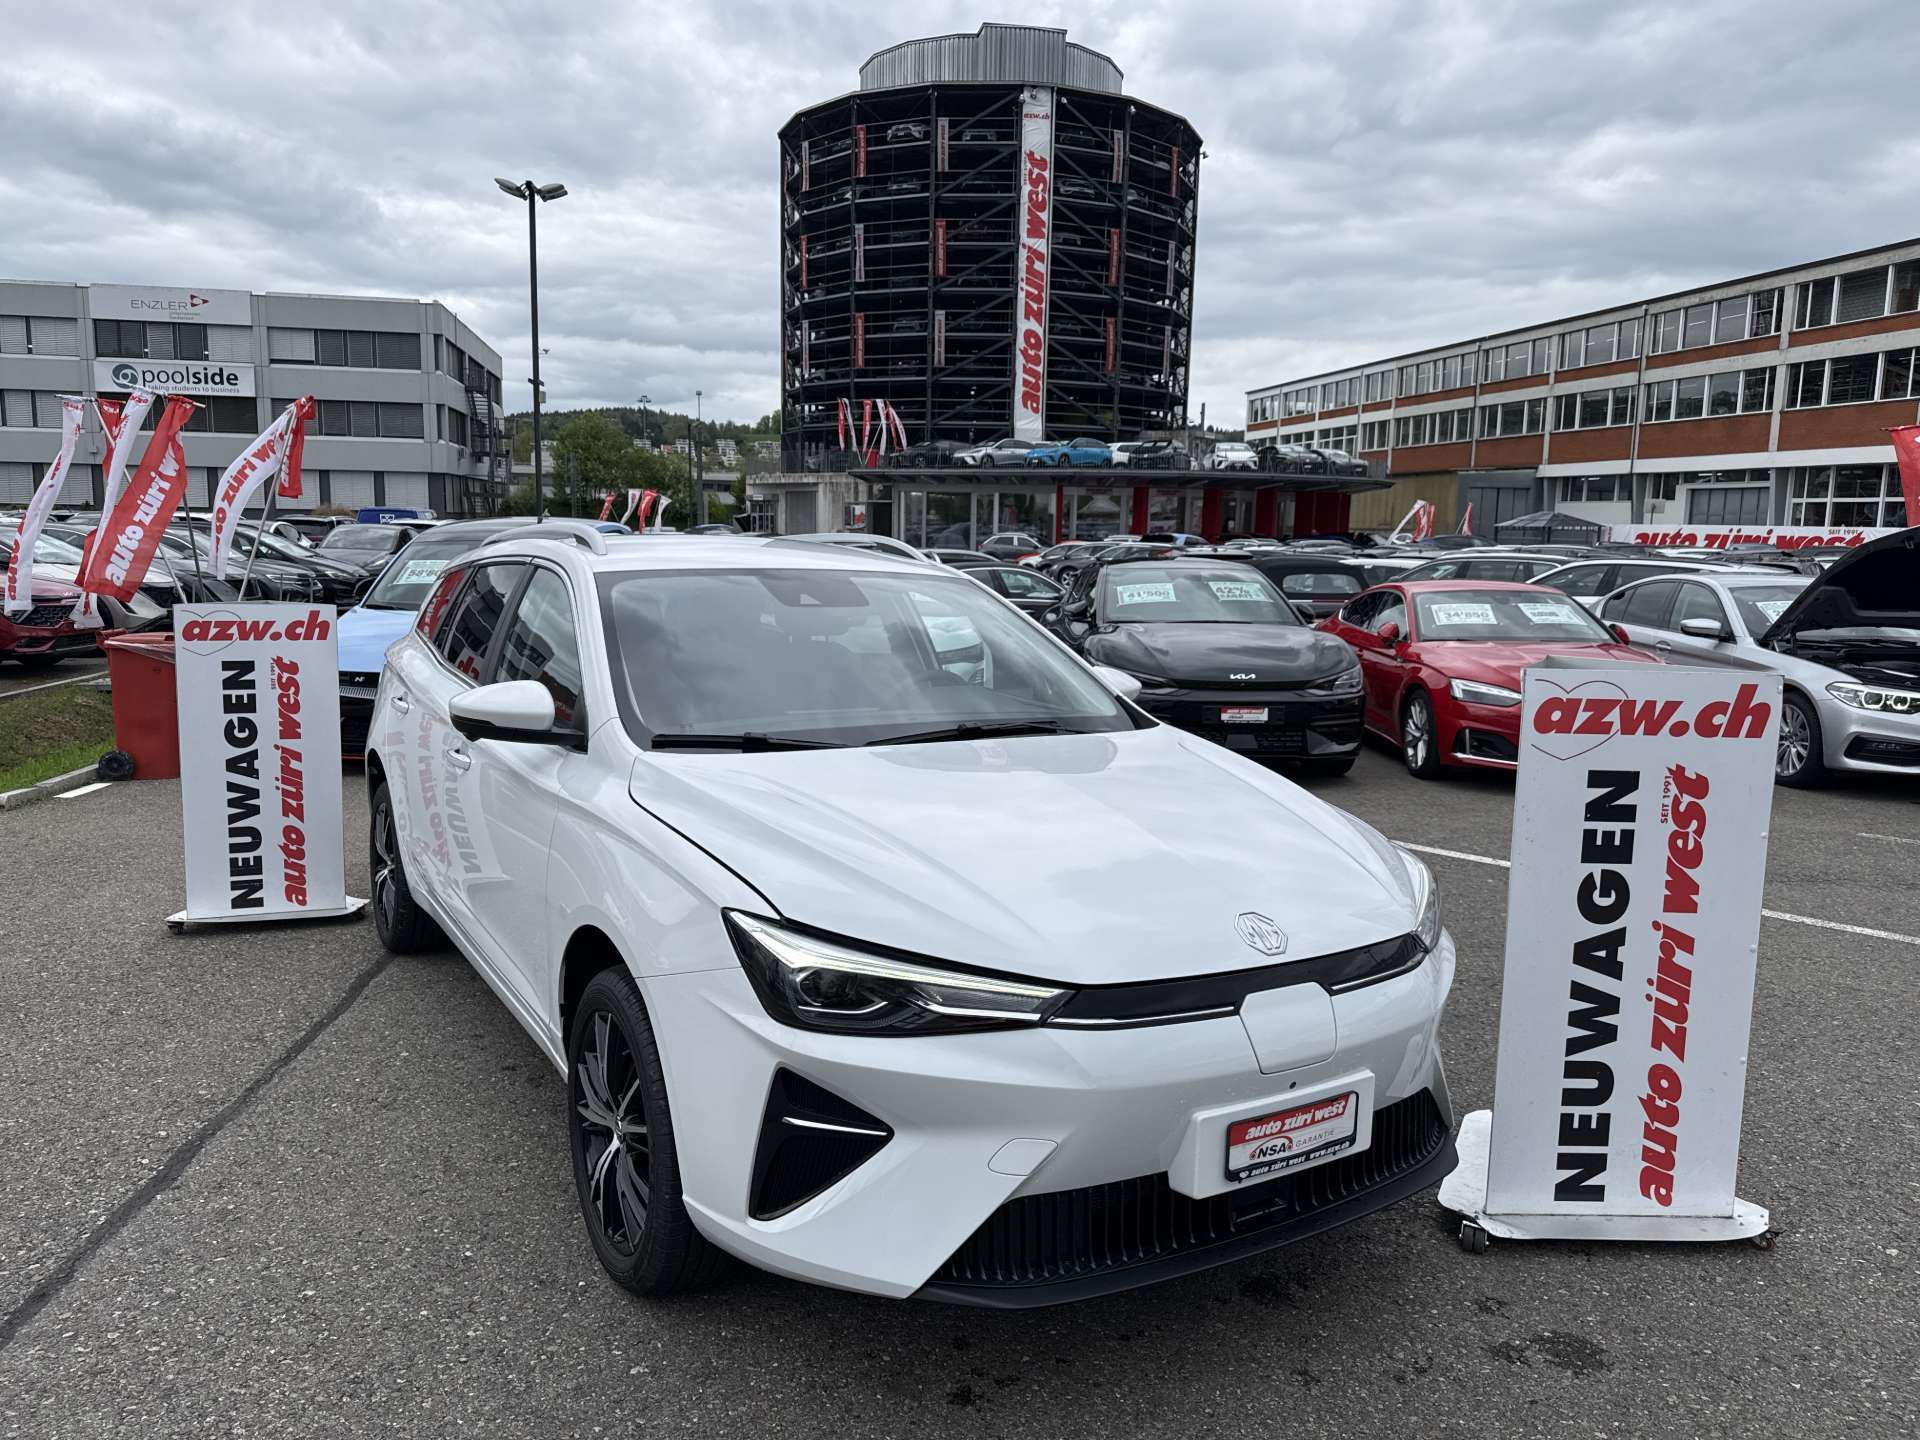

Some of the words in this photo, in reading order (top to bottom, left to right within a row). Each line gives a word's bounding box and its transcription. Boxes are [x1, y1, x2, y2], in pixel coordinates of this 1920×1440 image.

[1025, 149, 1049, 239] west
[130, 299, 188, 311] ENZLER
[1018, 242, 1047, 329] züri
[141, 365, 239, 388] poolside
[1021, 329, 1042, 415] auto
[221, 457, 257, 508] züri
[105, 524, 144, 587] auto
[132, 471, 171, 527] züri
[181, 610, 331, 642] azw.ch
[271, 655, 303, 740] west
[1533, 683, 1772, 739] azw.ch
[221, 660, 265, 910] NEUWAGEN
[273, 744, 305, 824] züri
[1660, 803, 1669, 824] SEIT
[1662, 775, 1673, 799] 1991
[278, 824, 308, 907] auto
[1662, 763, 1710, 914] west
[1553, 769, 1641, 1203] NEUWAGEN
[1645, 919, 1696, 1064] züri
[1245, 1120, 1281, 1140] auto
[1282, 1108, 1315, 1132] züri
[1314, 1100, 1346, 1122] west
[1257, 1142, 1287, 1160] NSA
[1295, 1129, 1335, 1148] GARANTIE
[1637, 1063, 1683, 1208] auto
[1250, 1166, 1269, 1177] auto
